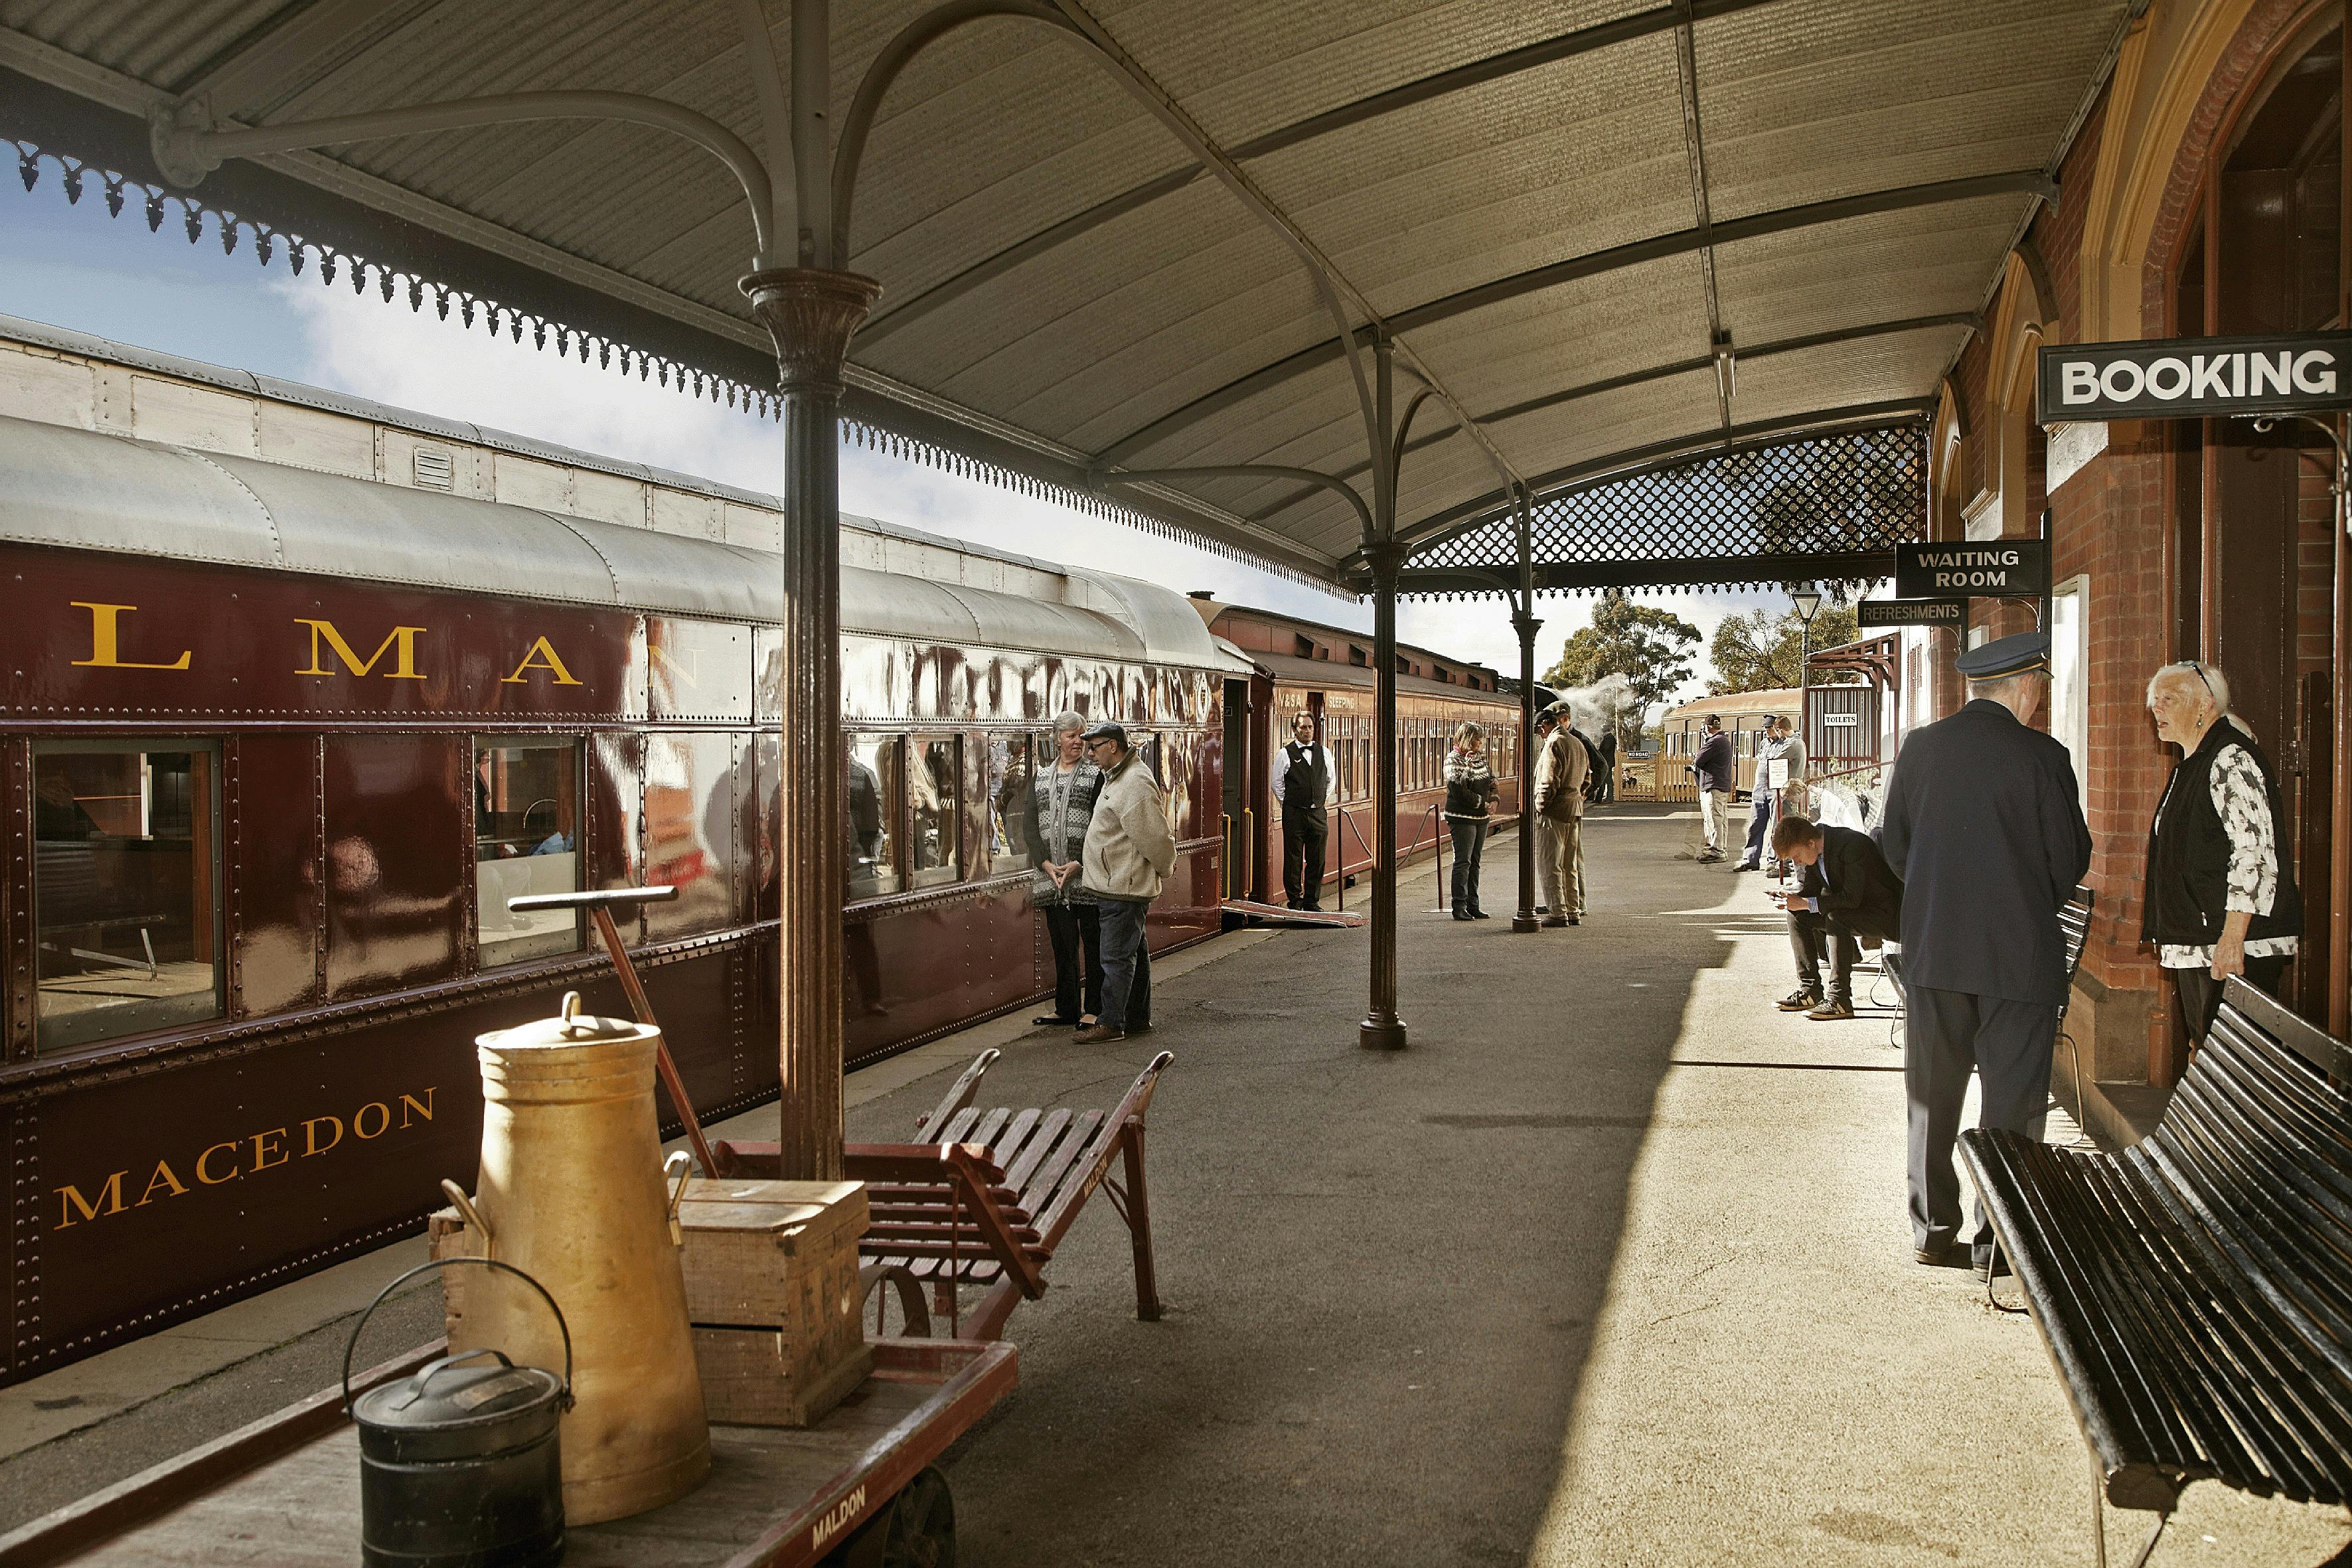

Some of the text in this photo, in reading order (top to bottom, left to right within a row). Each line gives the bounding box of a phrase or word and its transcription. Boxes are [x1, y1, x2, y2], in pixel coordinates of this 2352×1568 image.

[2061, 350, 2337, 405] BOOKING
[1918, 550, 2019, 568] WAITING
[1935, 571, 2006, 588] ROOM
[1863, 604, 1960, 621] REFRESHMENTS
[1329, 696, 1354, 709] SLEEPING
[53, 1087, 438, 1231] MACEDON
[1083, 1154, 1108, 1200] MALDON
[812, 1484, 866, 1551] MALDON
